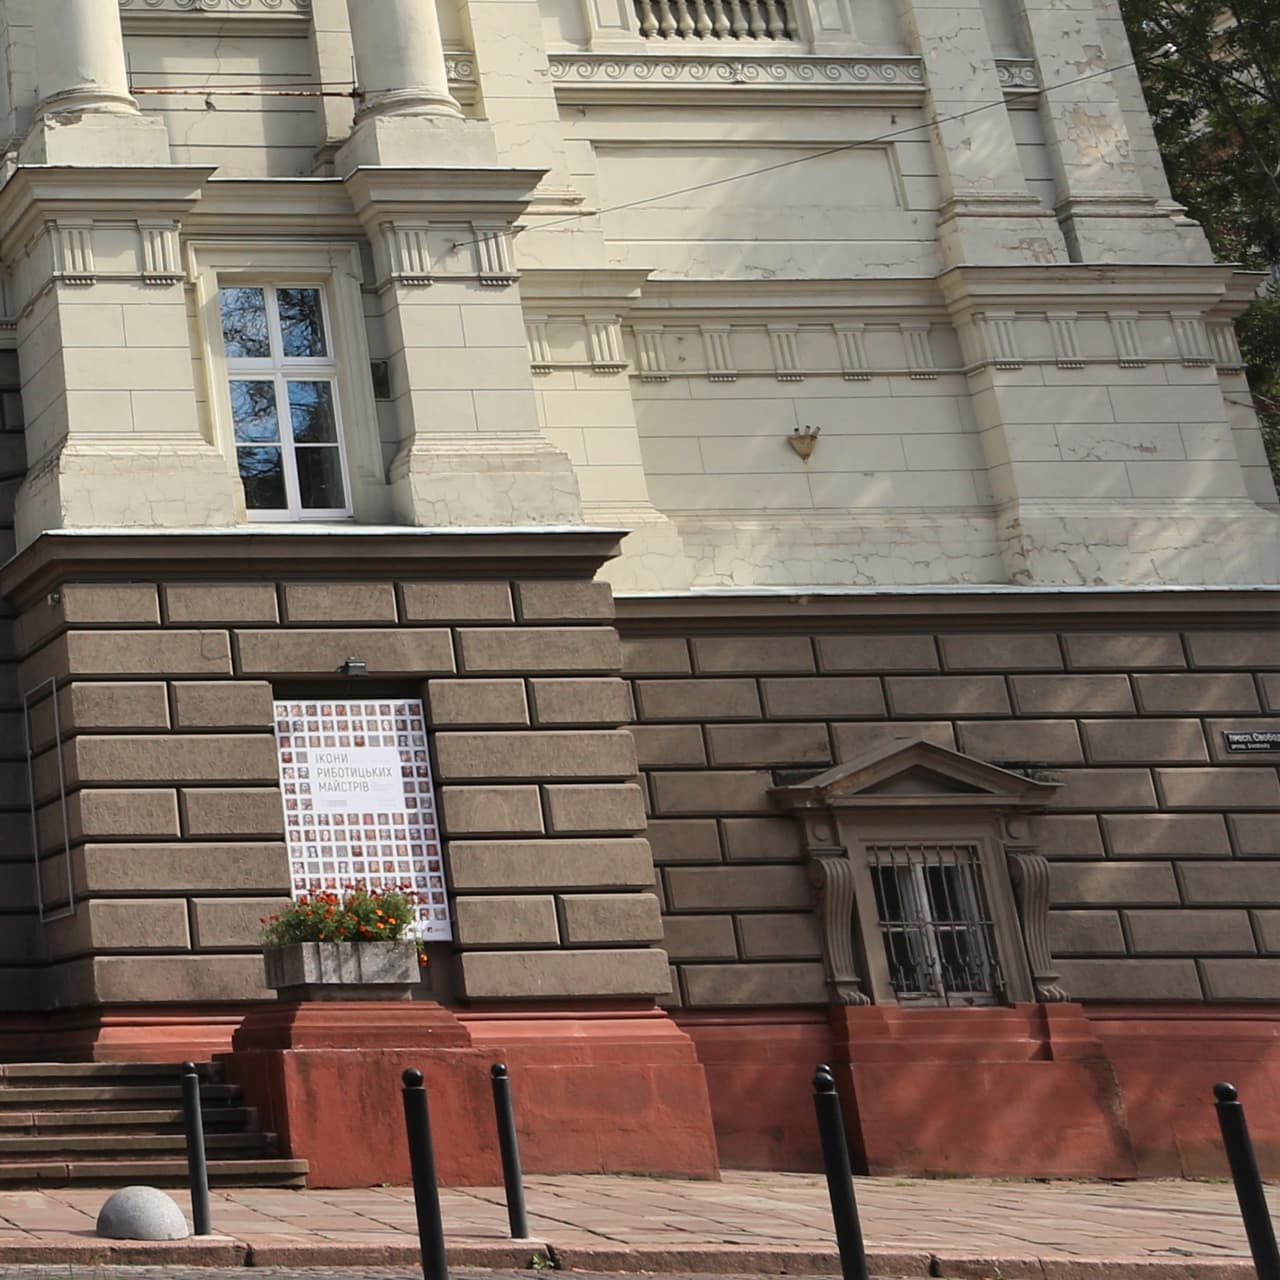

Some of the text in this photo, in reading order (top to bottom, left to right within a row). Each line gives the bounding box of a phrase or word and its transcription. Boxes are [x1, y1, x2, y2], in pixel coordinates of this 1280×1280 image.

[315, 752, 349, 764] ІКОНИ
[316, 767, 393, 779] РИБОТИЦЬКИХ
[318, 780, 370, 793] МАЙСТРІВ
